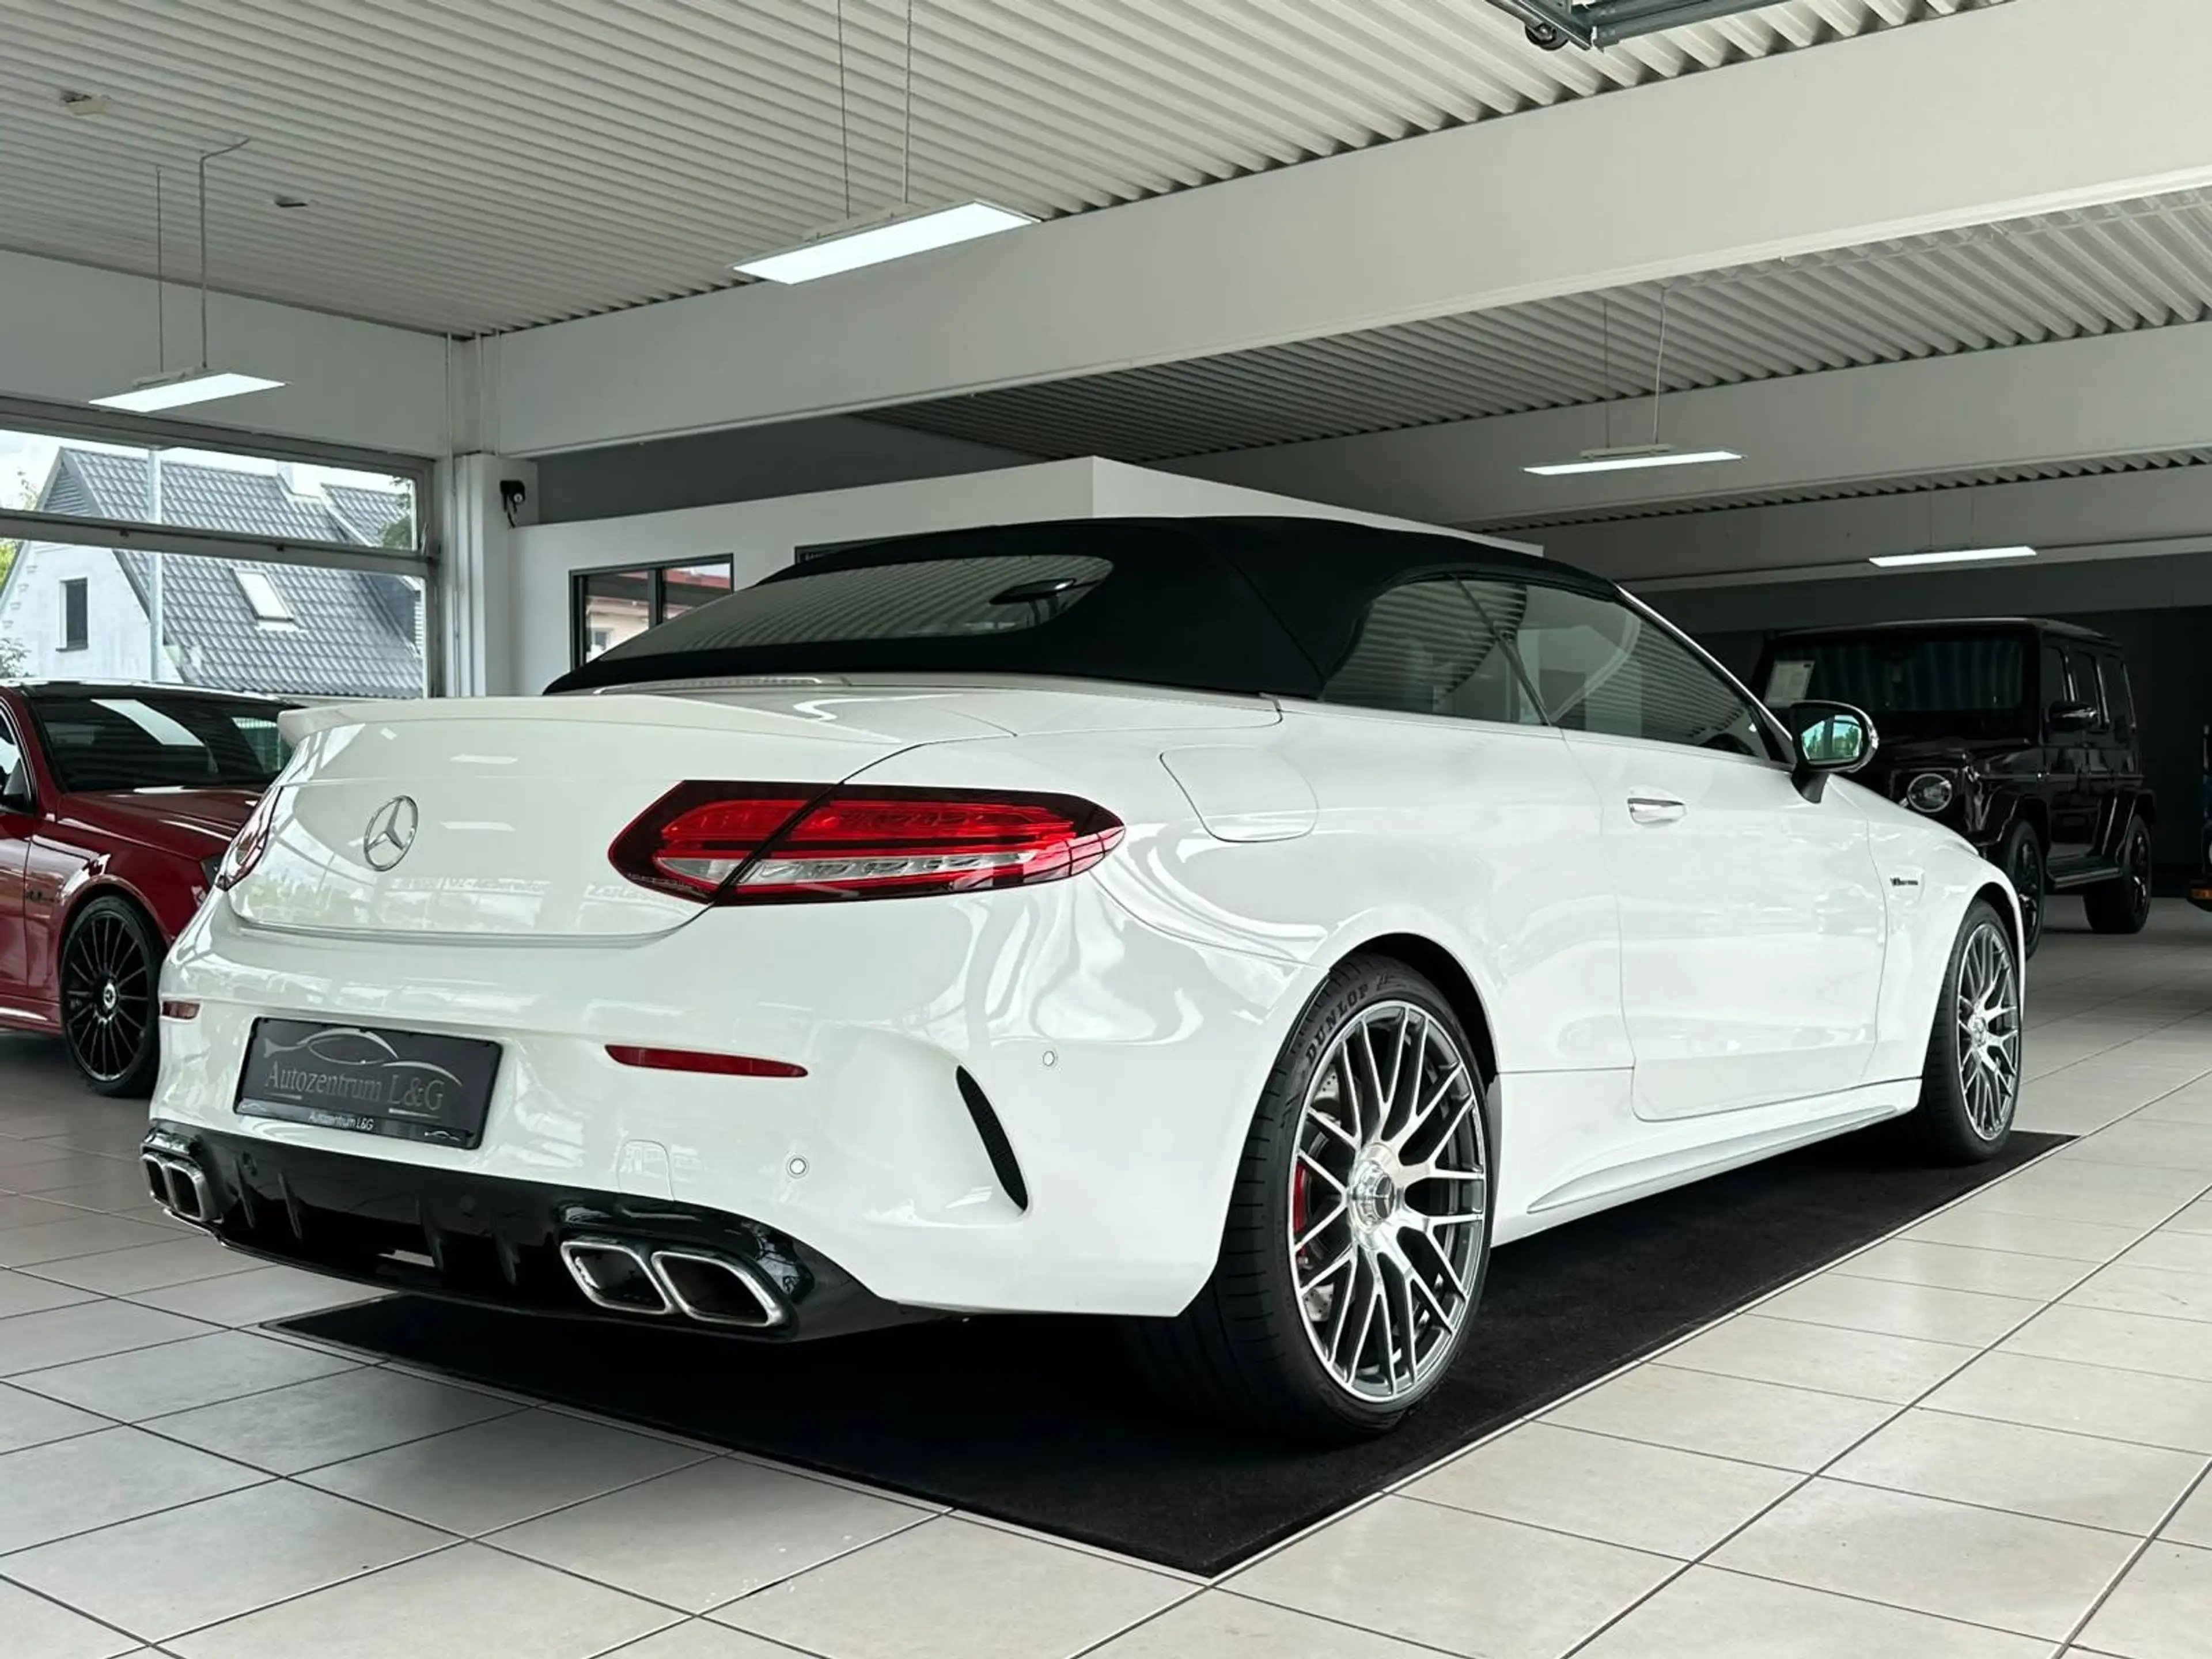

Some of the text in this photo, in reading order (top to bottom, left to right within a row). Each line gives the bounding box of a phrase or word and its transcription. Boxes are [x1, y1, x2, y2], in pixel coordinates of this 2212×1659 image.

[1306, 984, 1368, 1064] DUNLOP
[264, 1060, 445, 1111] Autozentrum L&G
[356, 1118, 374, 1130] L&G
